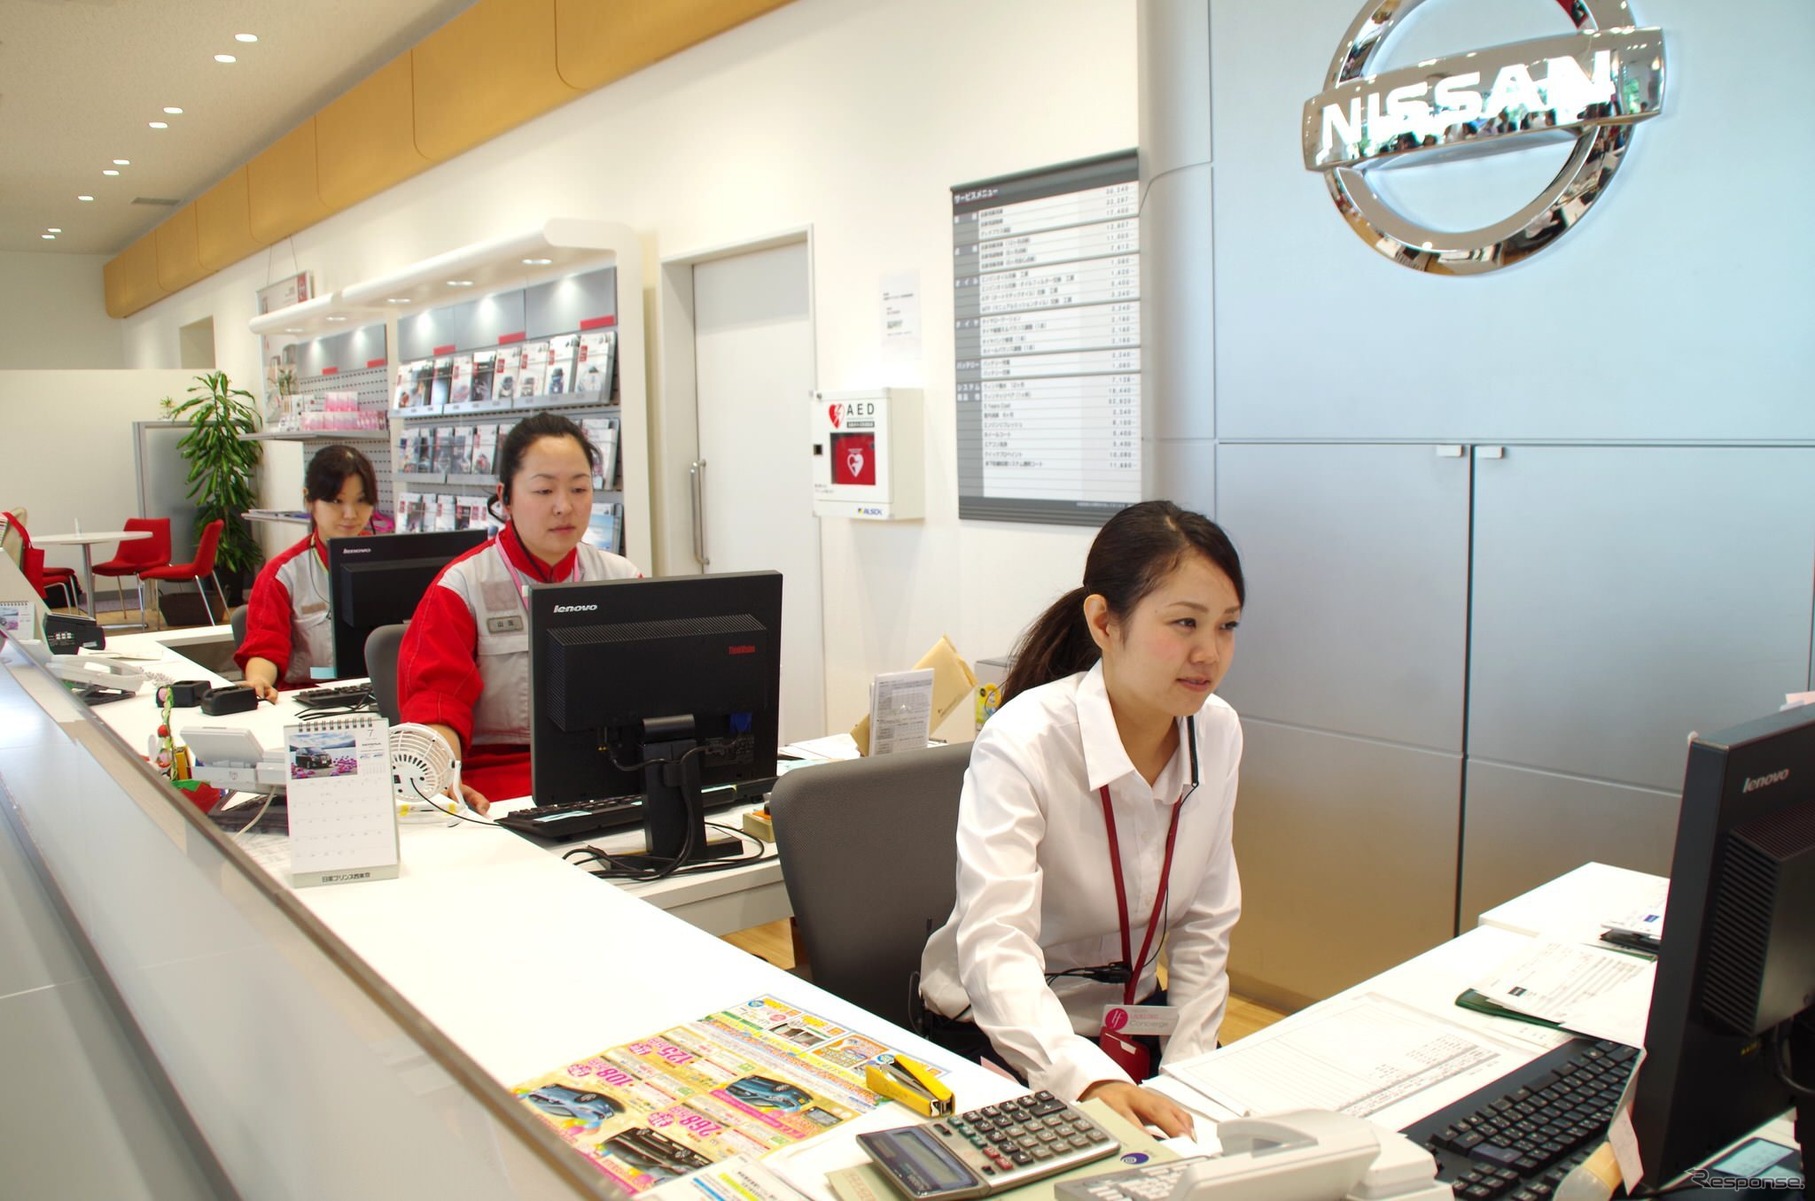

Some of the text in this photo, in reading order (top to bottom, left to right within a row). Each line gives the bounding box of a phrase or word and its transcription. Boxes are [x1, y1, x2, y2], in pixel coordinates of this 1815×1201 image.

[1320, 50, 1615, 150] NISSAN
[954, 188, 999, 204] サービスメニュー
[847, 403, 875, 416] AED
[553, 604, 598, 613] lenovo
[1742, 767, 1790, 794] lenovo
